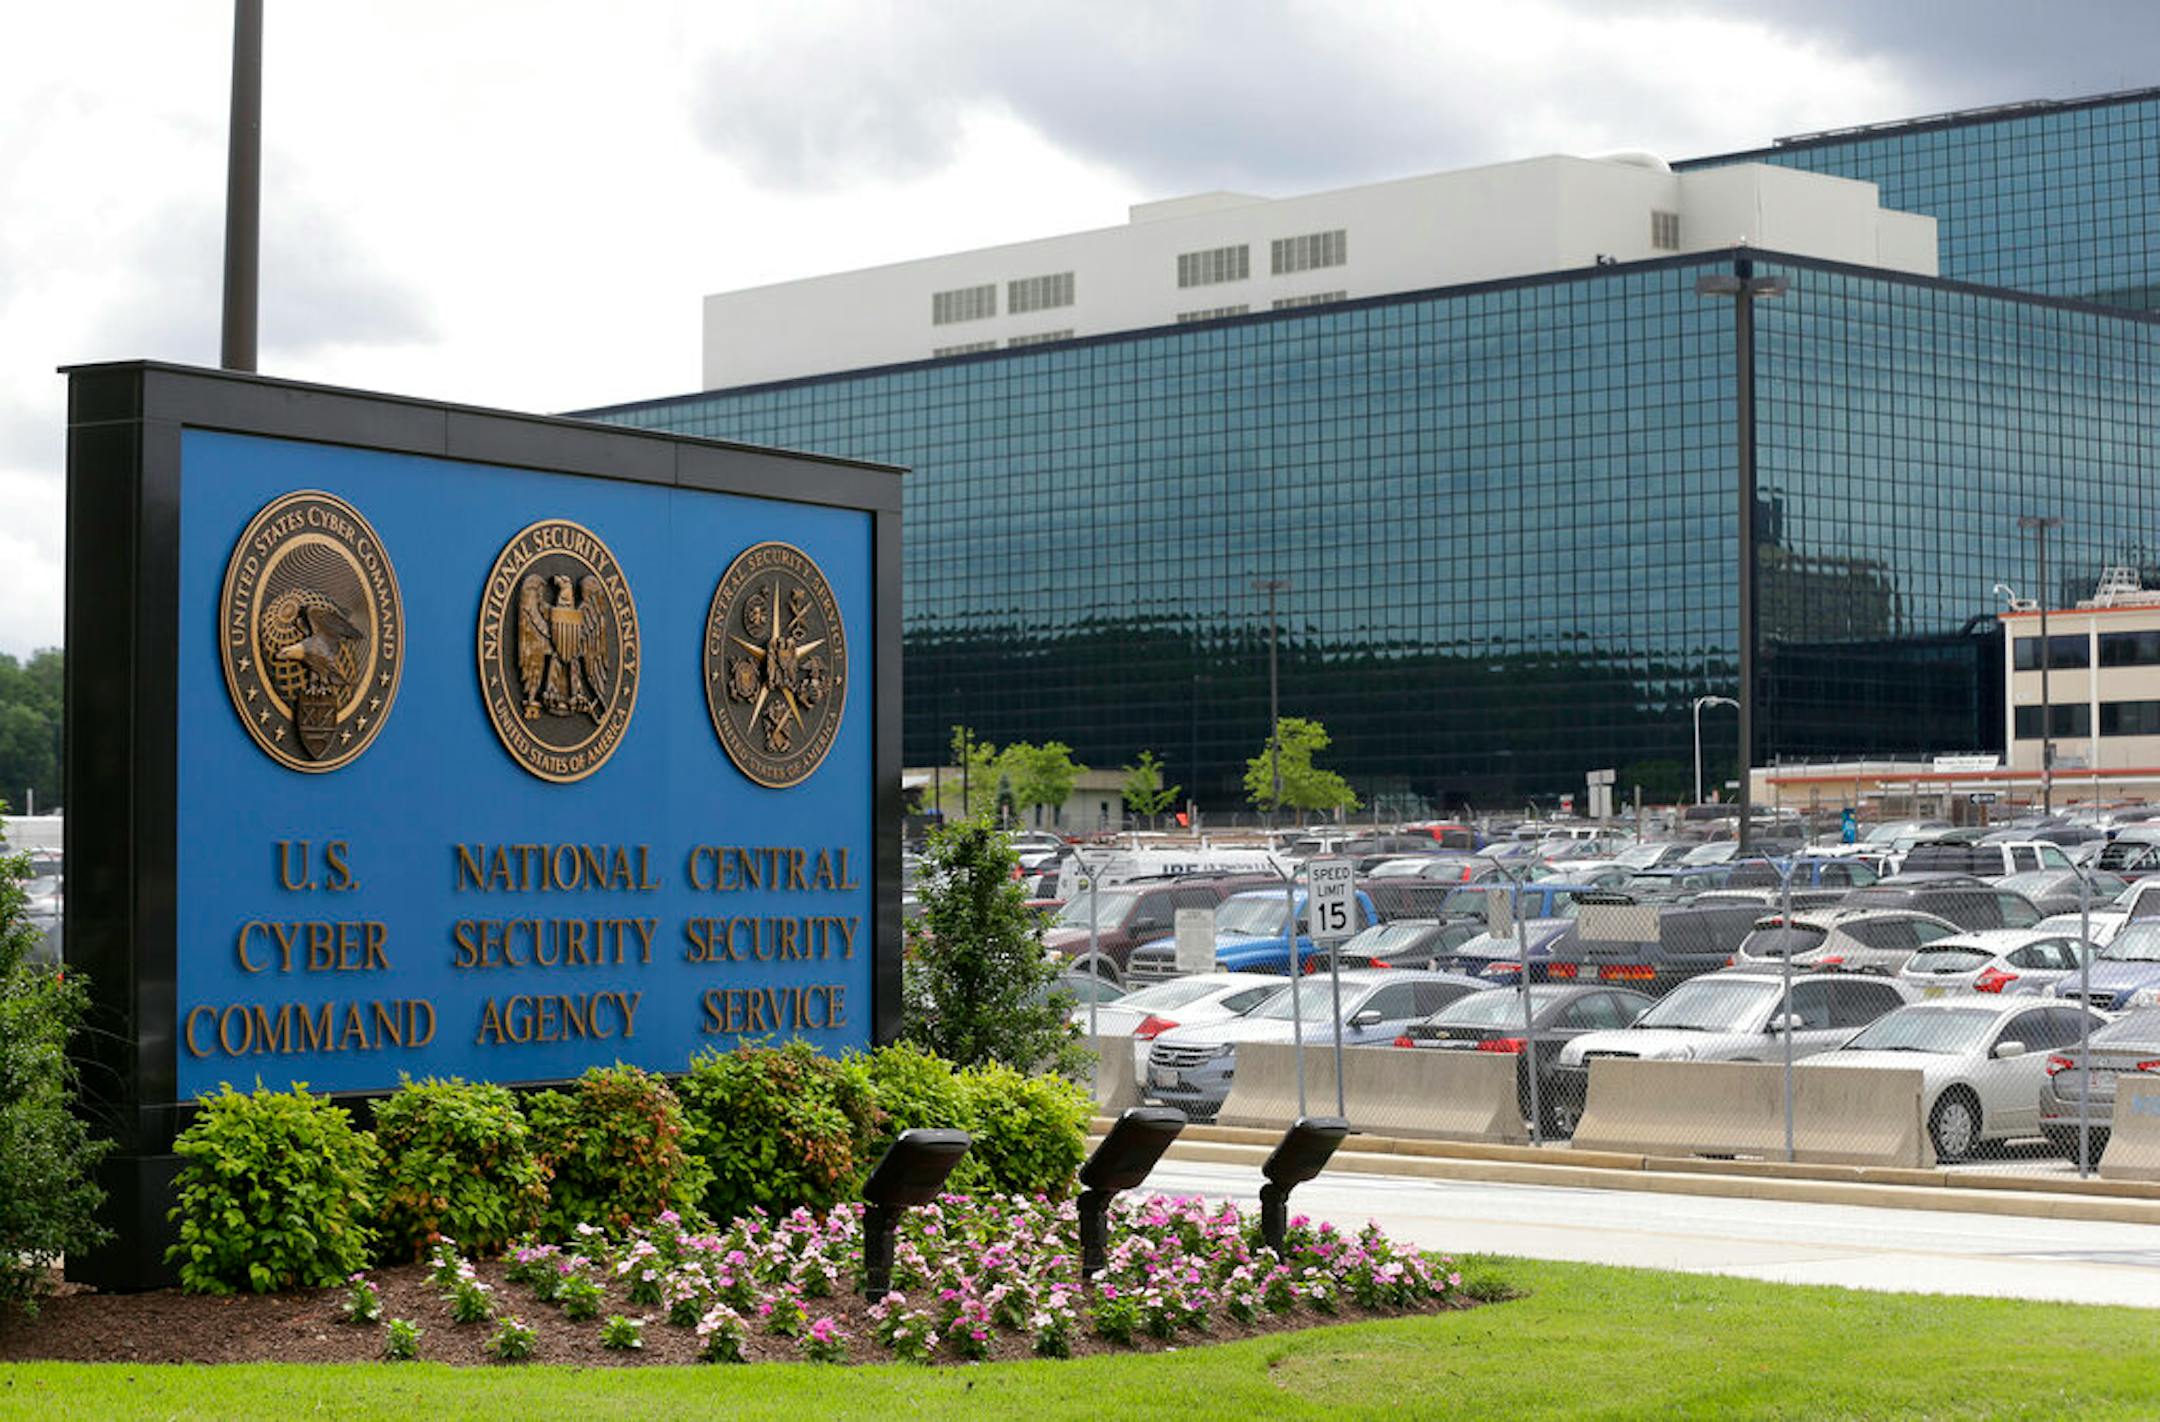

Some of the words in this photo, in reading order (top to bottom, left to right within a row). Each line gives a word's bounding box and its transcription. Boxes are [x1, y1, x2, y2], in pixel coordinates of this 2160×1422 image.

[232, 556, 260, 647] UNITED
[254, 509, 305, 555] STATES
[307, 506, 356, 546] CYBER
[357, 538, 395, 660] COMMAND
[748, 550, 810, 577] SECURITY
[484, 543, 534, 660] NATIONAL
[532, 526, 610, 572] SECURITY
[605, 570, 637, 674] AGENCY
[495, 696, 530, 755] UNITED
[529, 749, 569, 774] STATES
[570, 754, 585, 771] OF
[587, 708, 627, 765] AMERICA
[278, 840, 360, 891] U.S.
[456, 843, 661, 891] NATIONAL
[690, 845, 860, 891] CENTRAL
[1313, 867, 1350, 881] SPEED
[1318, 884, 1344, 897] LIMIT
[686, 916, 861, 963] SECURITY
[1318, 902, 1346, 931] 15
[238, 920, 392, 972] CYBER
[454, 918, 659, 967] SECURITY
[186, 999, 436, 1057] COMMAND
[476, 991, 644, 1044] AGENCY
[704, 984, 847, 1033] SERVICE
